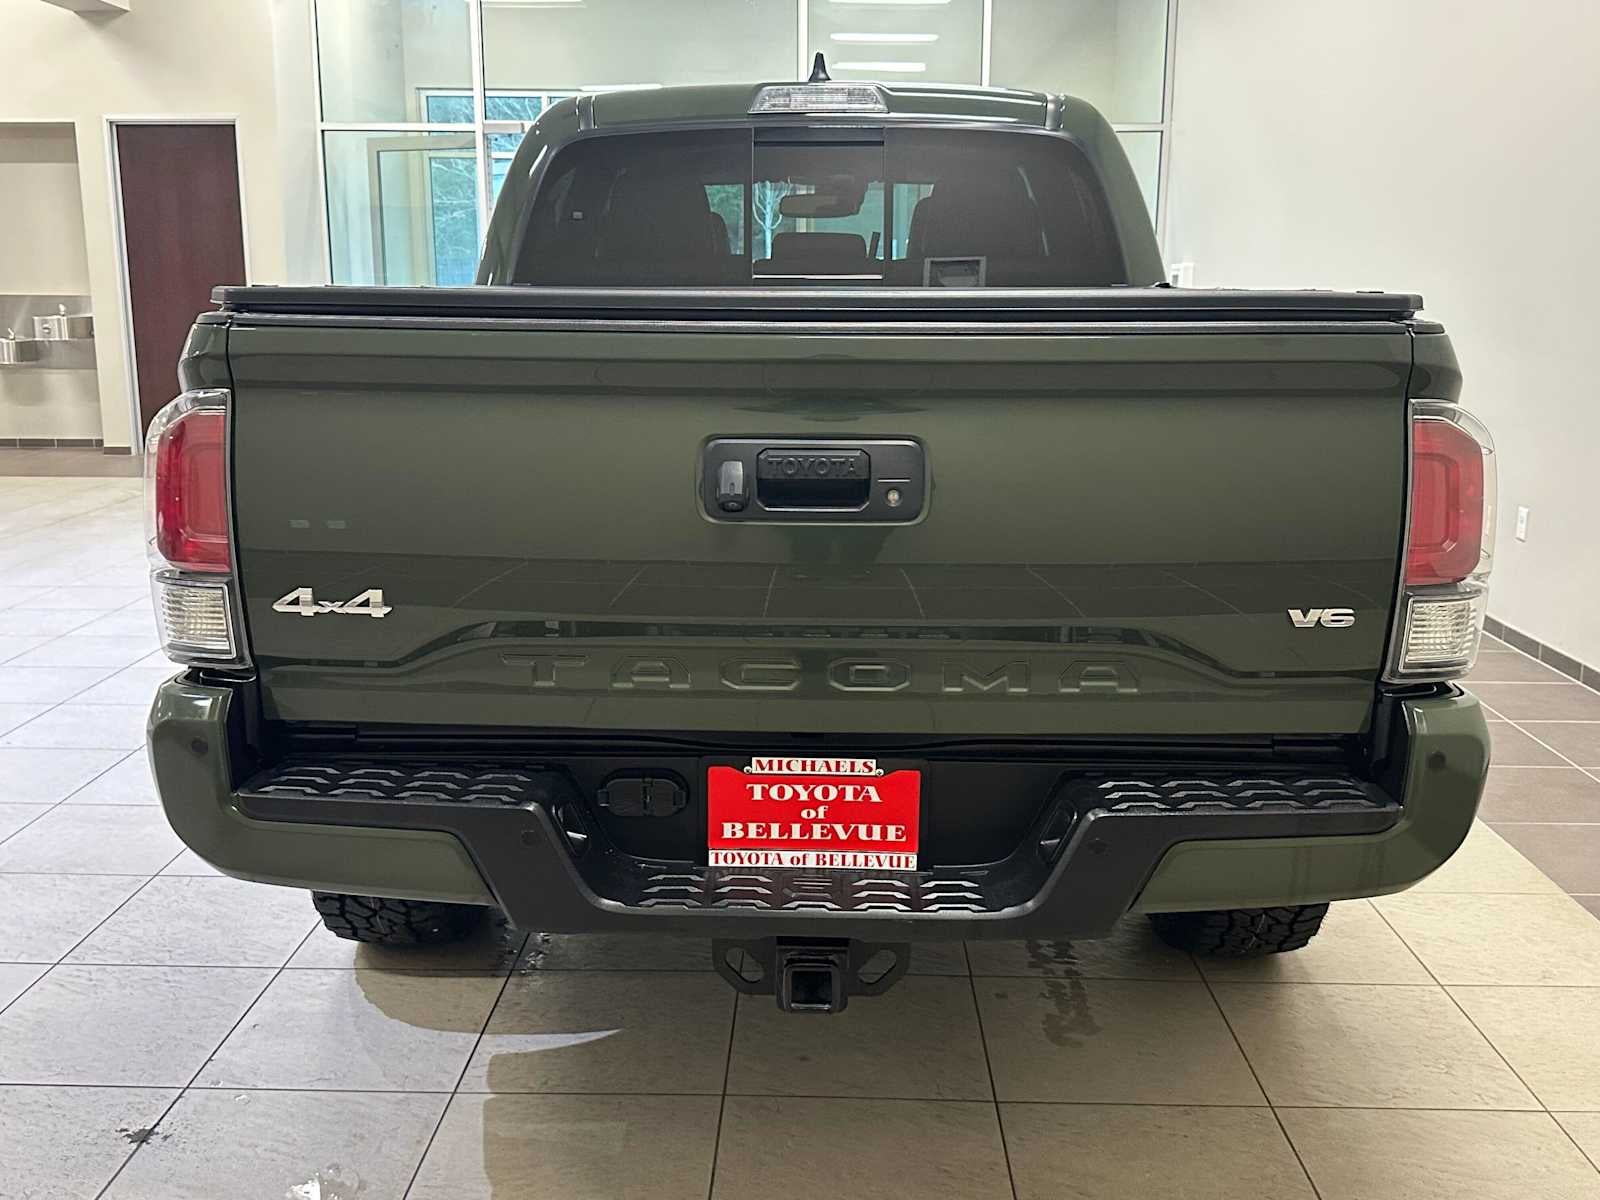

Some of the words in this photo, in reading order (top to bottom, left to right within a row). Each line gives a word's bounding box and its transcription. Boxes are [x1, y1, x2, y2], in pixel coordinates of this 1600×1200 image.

[767, 457, 862, 477] TOYOTA
[272, 587, 393, 617] 4x4
[1287, 608, 1356, 628] V6
[501, 653, 1140, 693] TACOMA
[754, 759, 875, 773] MICHAELS
[746, 783, 883, 803] TOYOTA
[800, 805, 829, 820] of
[721, 822, 907, 842] BELLEVUE
[710, 851, 784, 866] TOYOTA
[790, 853, 809, 866] of
[815, 853, 915, 869] BELLEVUE
